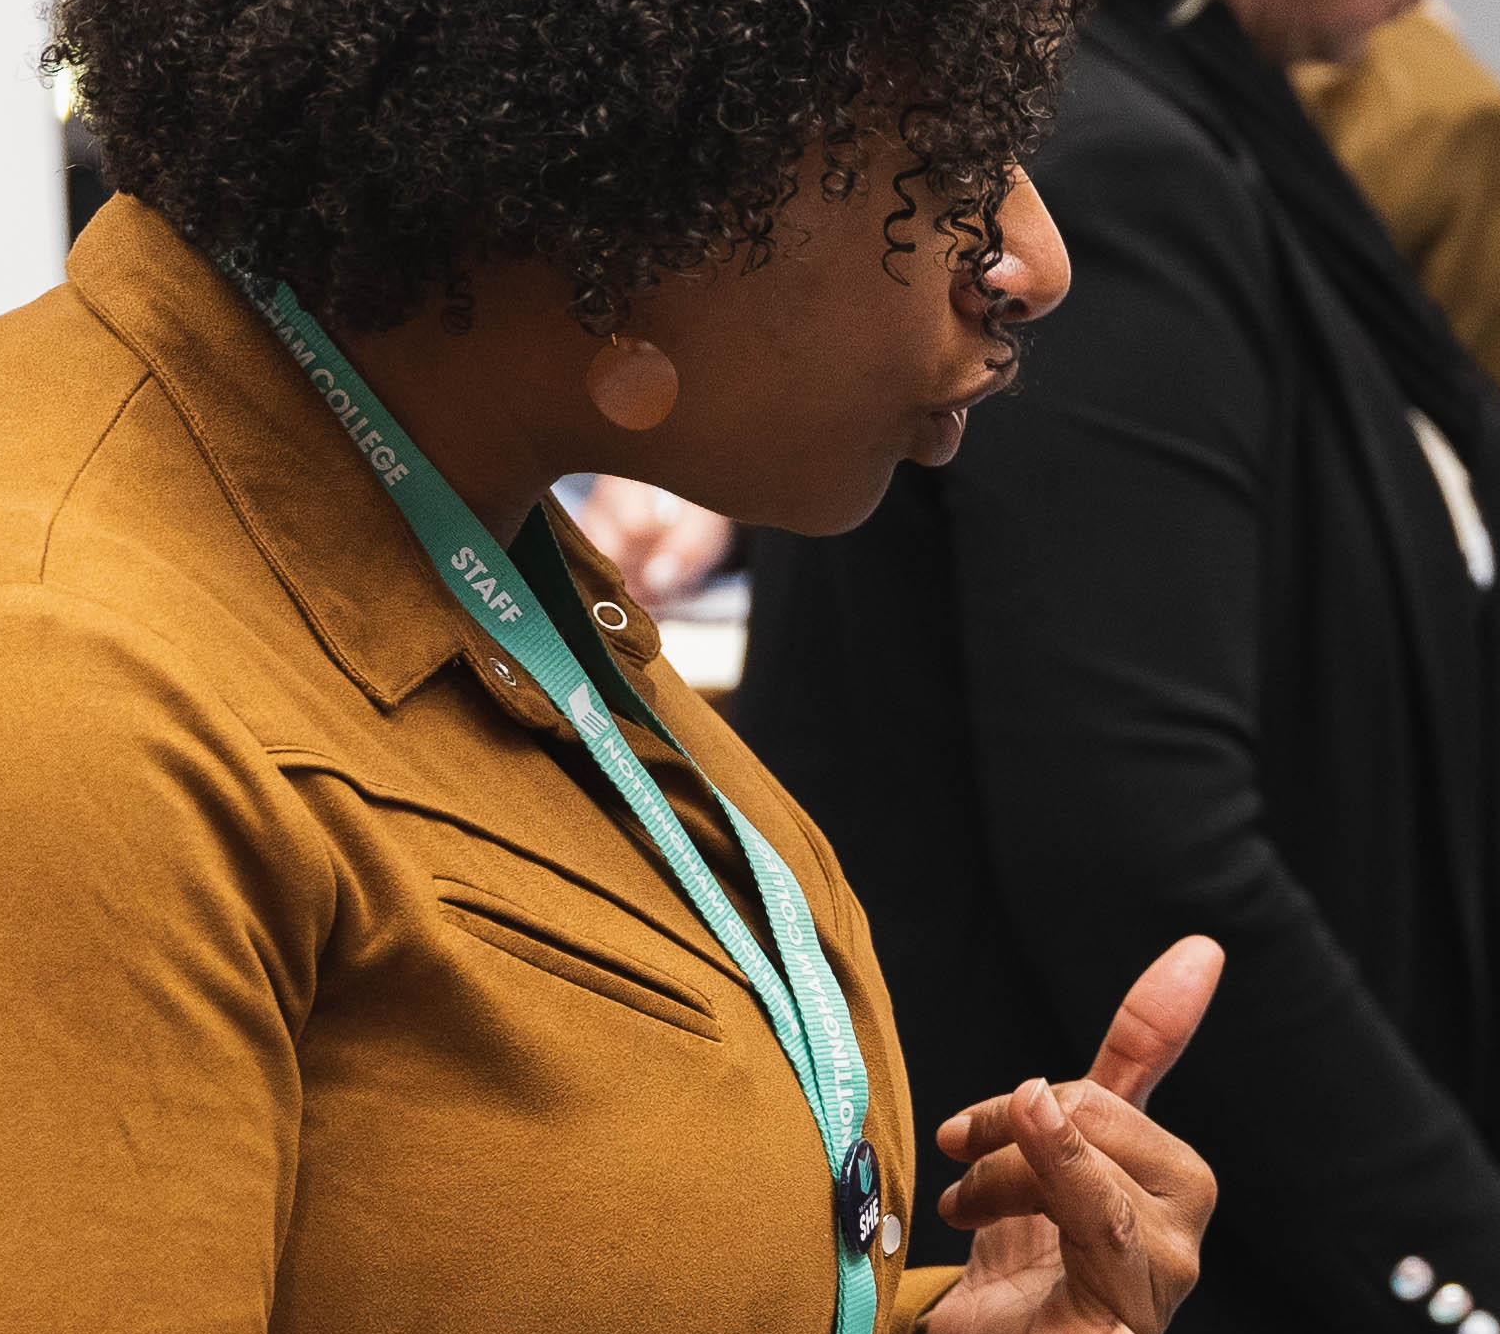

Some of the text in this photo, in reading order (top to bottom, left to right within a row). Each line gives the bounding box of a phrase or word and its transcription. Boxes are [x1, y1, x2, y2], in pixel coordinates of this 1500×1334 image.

[309, 368, 410, 487] COLLEGE
[450, 546, 523, 624] STAFF
[602, 737, 726, 917] NOTTINGHAM
[797, 952, 854, 1151] NOTTINGHAM
[860, 1197, 879, 1242] SHE
